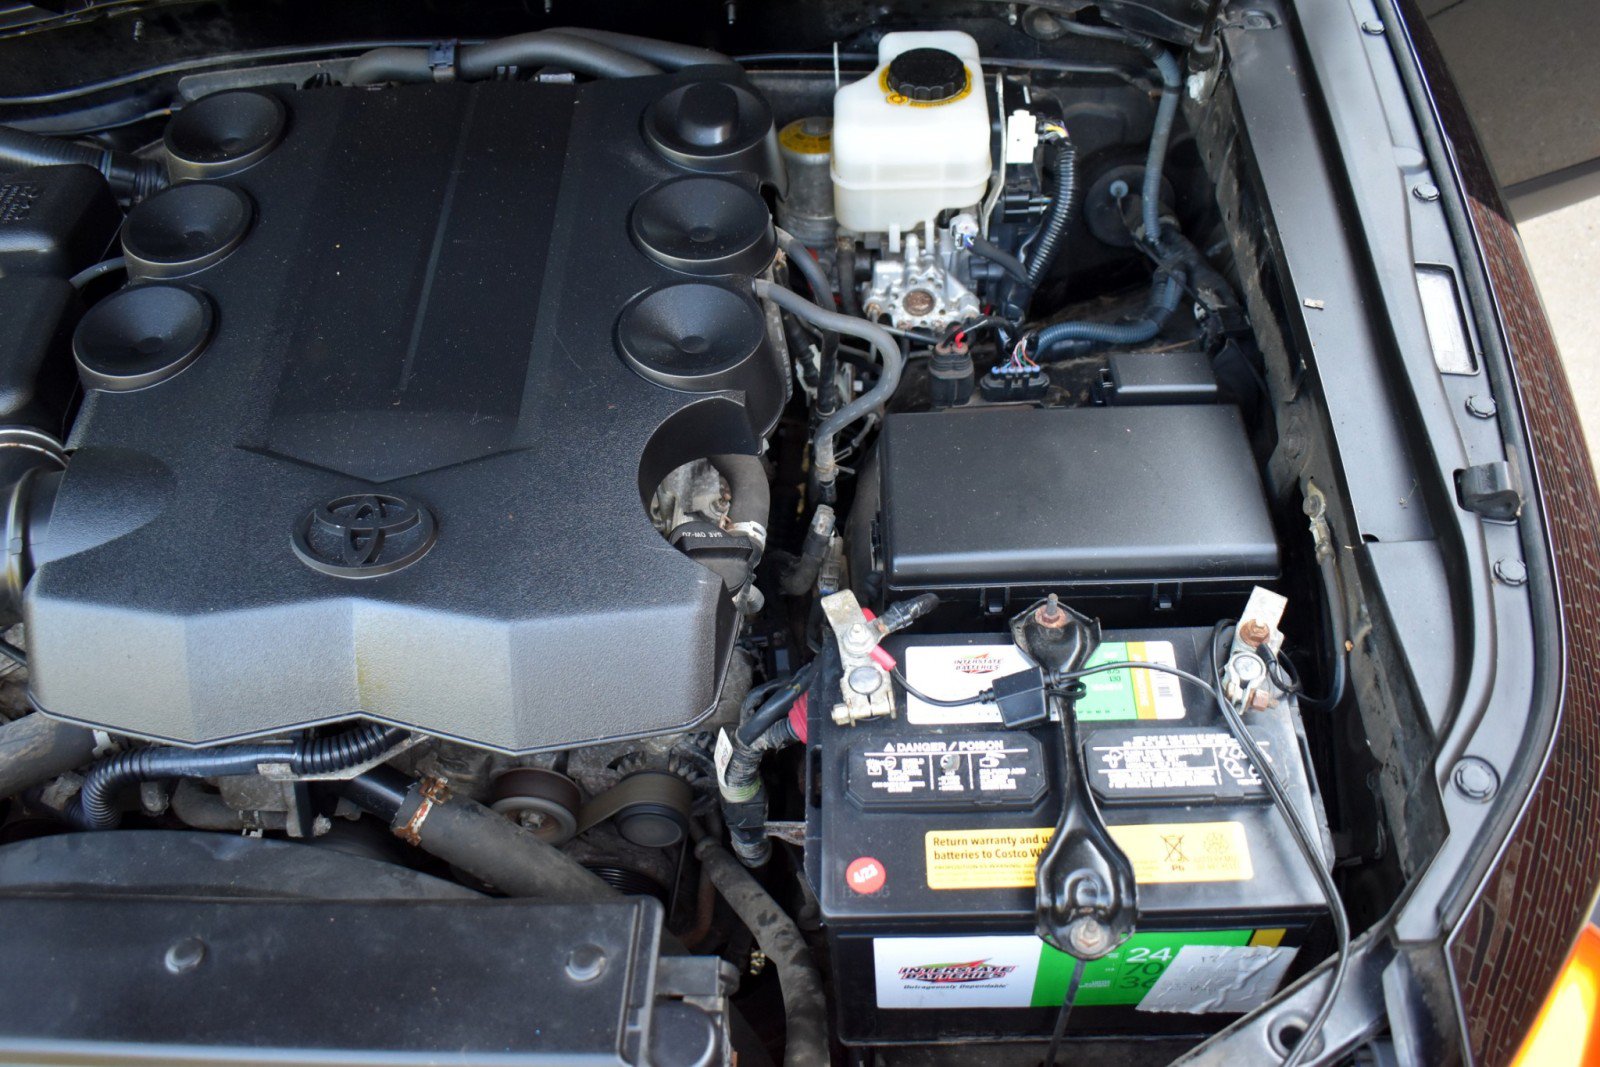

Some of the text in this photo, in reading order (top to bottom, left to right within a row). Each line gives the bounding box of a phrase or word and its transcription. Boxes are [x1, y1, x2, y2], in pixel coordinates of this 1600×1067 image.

[896, 742, 947, 752] DANGER
[958, 740, 1004, 750] POISON
[933, 837, 968, 846] Return
[971, 836, 1017, 846] warranty
[1020, 834, 1039, 844] and
[934, 849, 980, 860] batteries
[982, 850, 993, 859] to
[995, 849, 1028, 859] Costco
[1126, 946, 1173, 961] 24
[898, 965, 1016, 974] INTERSTATE
[1125, 962, 1165, 975] 70
[901, 972, 1007, 980] BATTERIES
